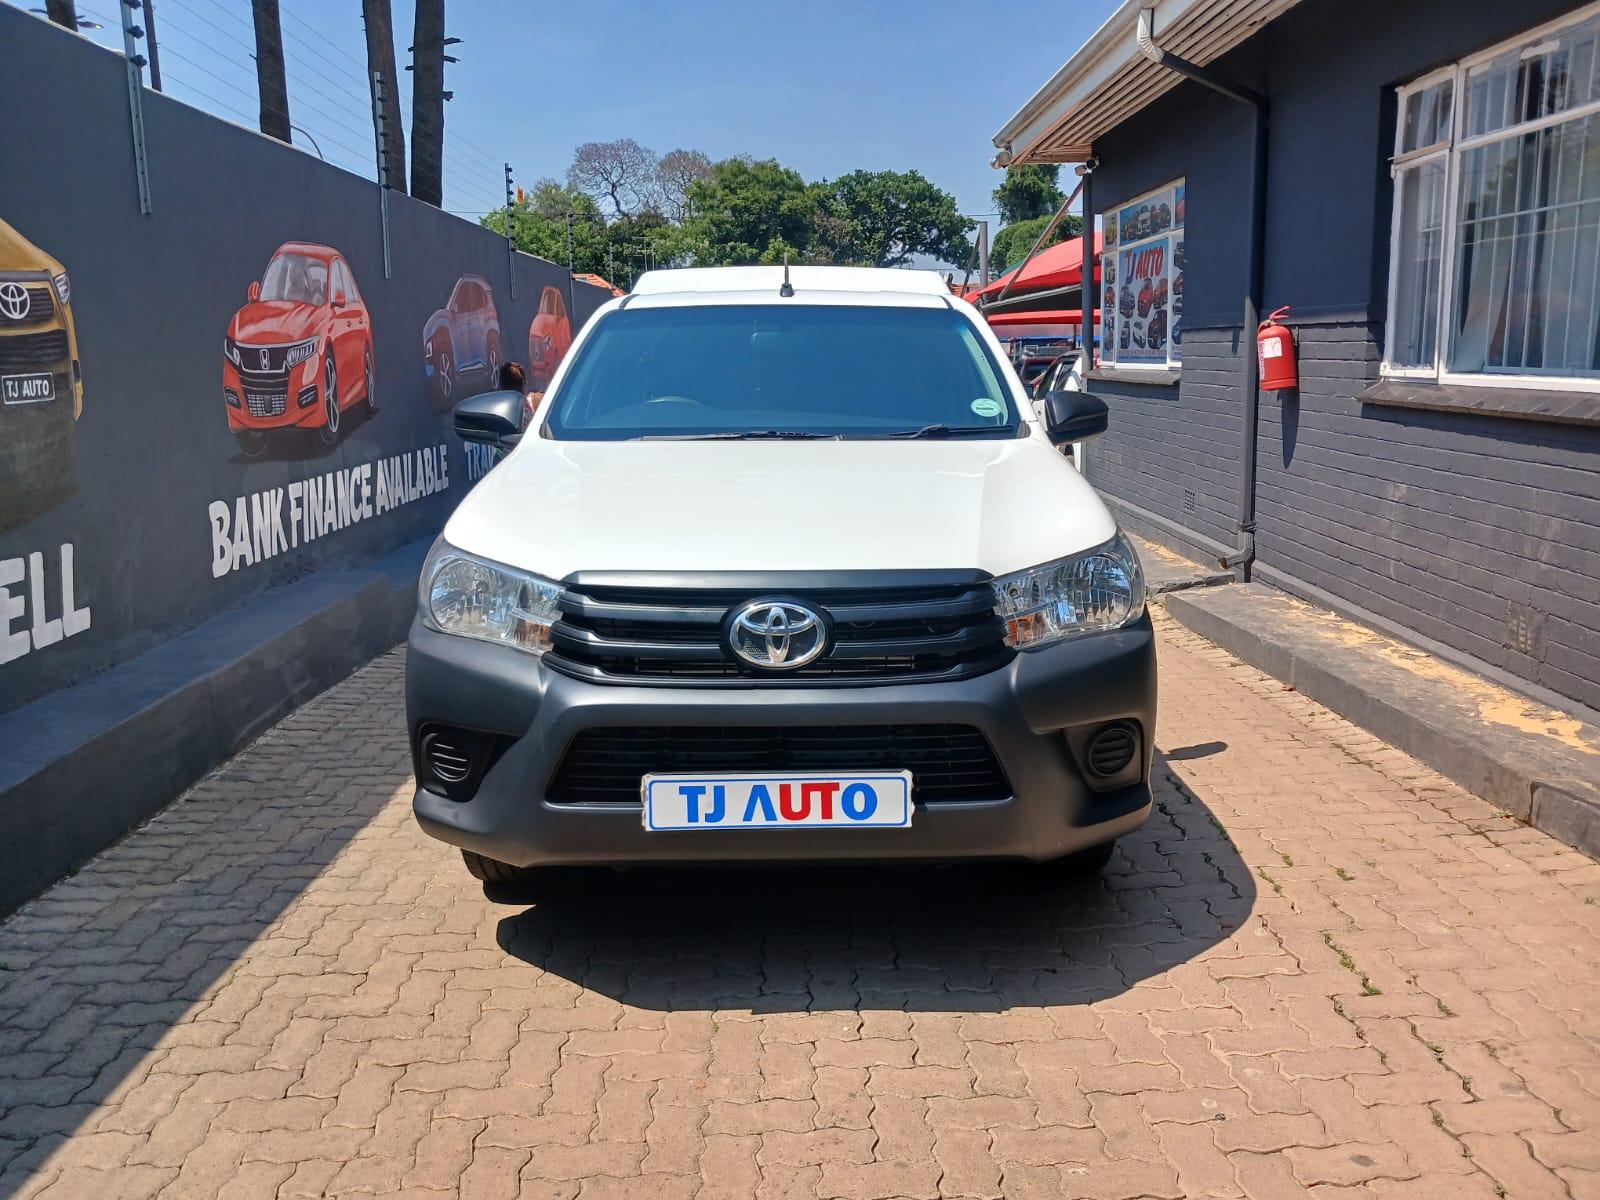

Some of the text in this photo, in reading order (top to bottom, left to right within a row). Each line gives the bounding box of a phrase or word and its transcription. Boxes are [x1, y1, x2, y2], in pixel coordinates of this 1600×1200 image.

[1125, 246, 1164, 285] TJ AUTO
[6, 379, 49, 398] TJ AUTO
[208, 444, 449, 578] BANK FINANCE AVAILABLE
[678, 782, 878, 823] TJ AUTO
